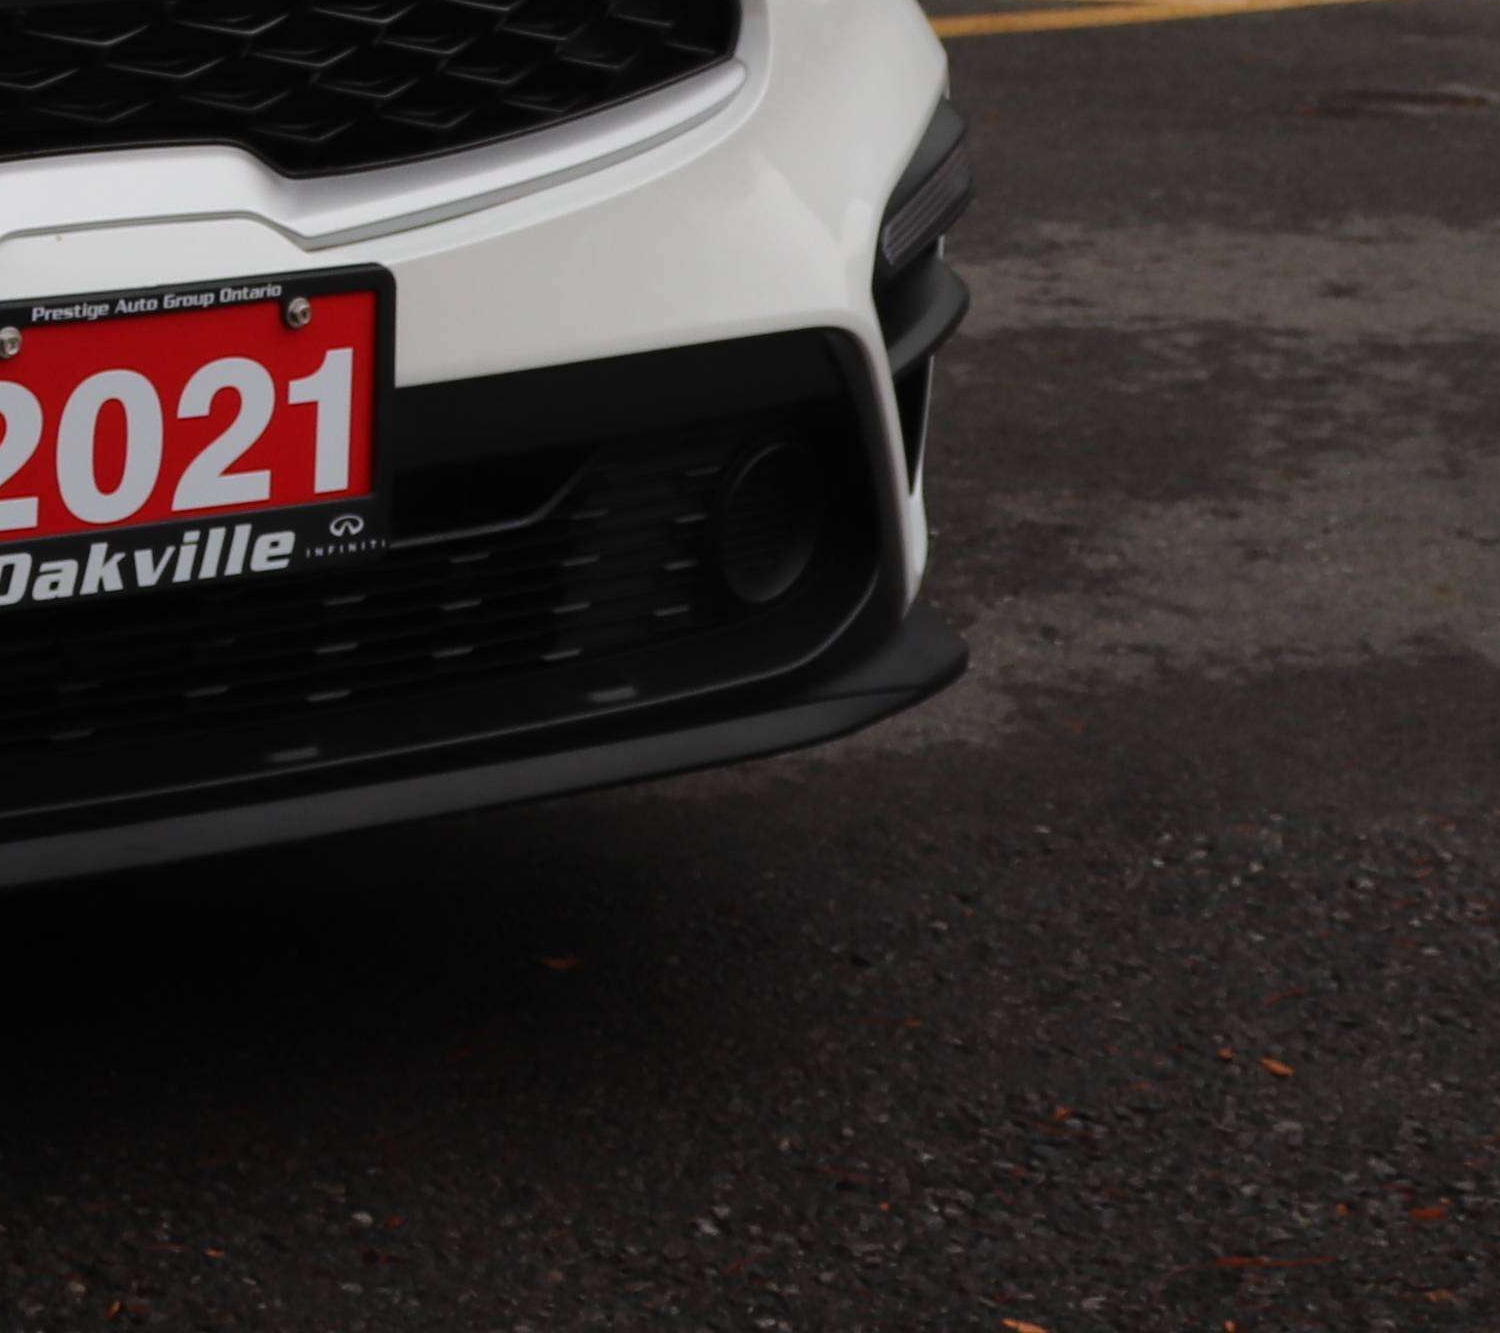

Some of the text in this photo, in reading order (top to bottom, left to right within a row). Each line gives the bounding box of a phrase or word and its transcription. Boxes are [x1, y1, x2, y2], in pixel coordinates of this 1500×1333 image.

[31, 283, 283, 322] Prestige Auto Group Ontario
[305, 538, 386, 559] INFINITI
